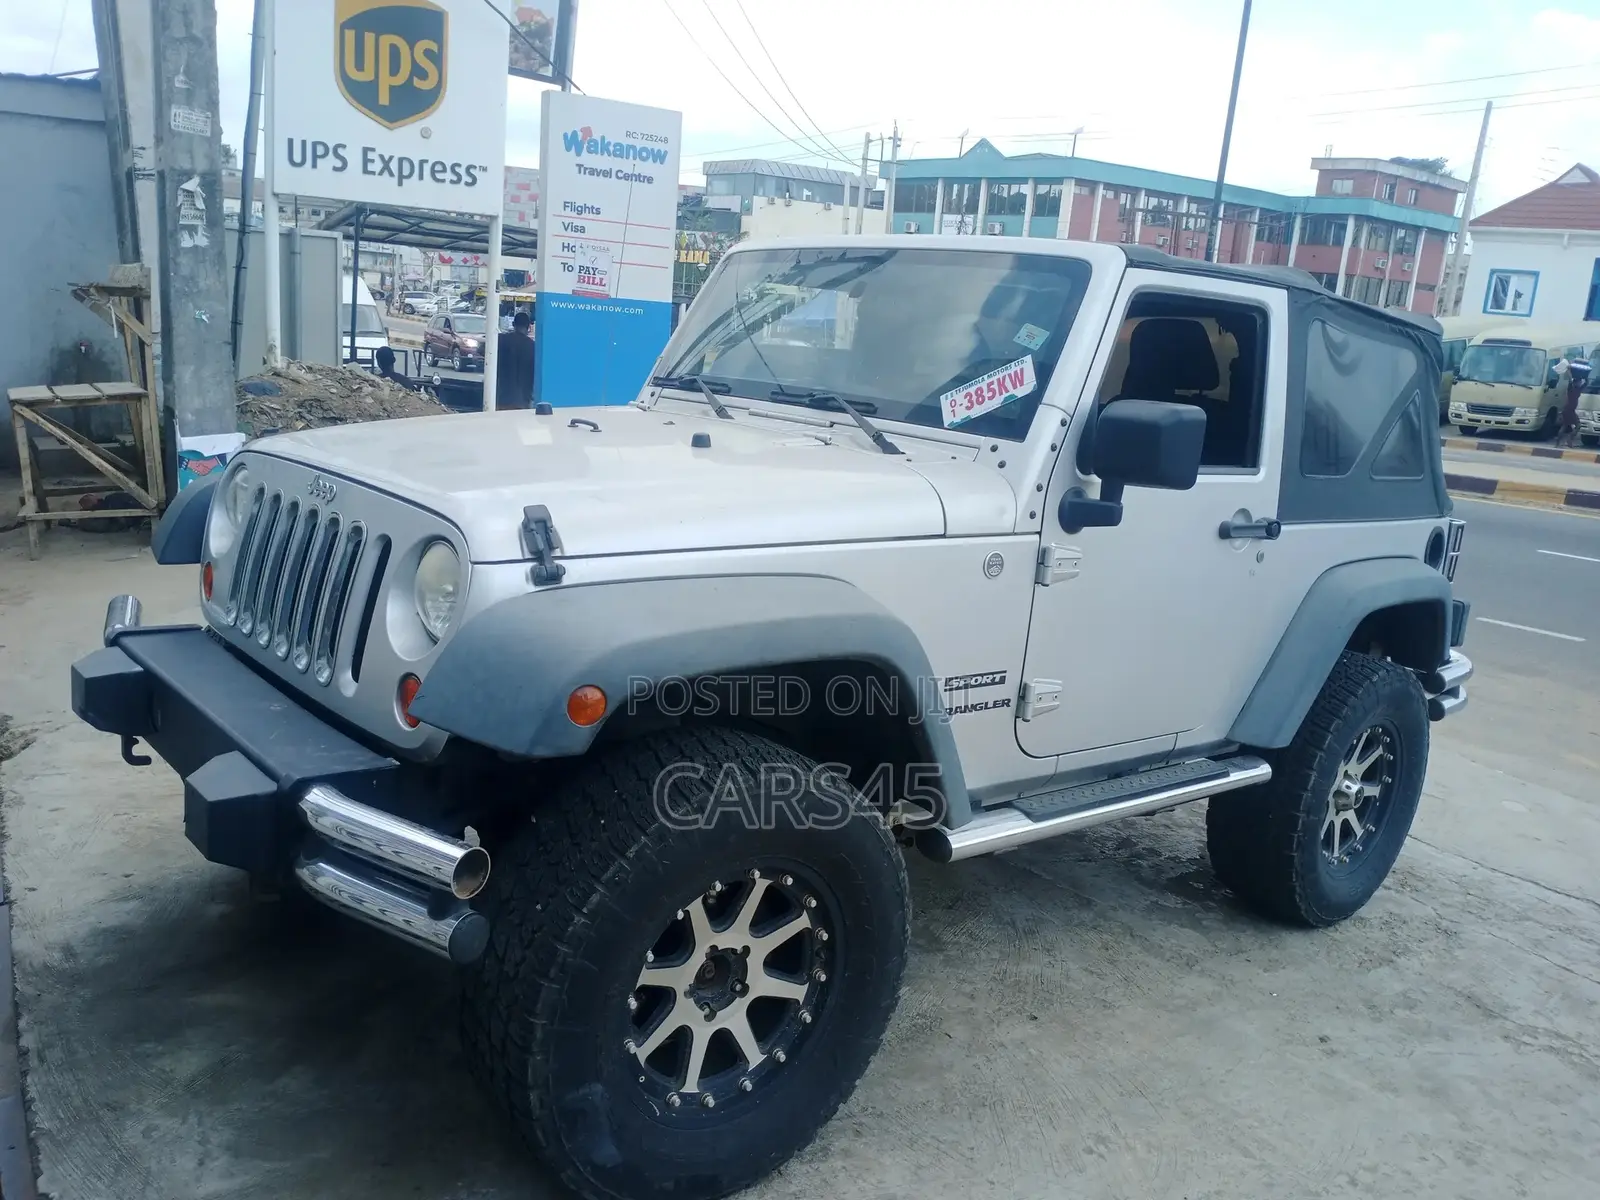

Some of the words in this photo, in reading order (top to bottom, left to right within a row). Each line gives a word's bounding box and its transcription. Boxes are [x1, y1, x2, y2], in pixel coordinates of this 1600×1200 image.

[344, 29, 439, 106] ups
[625, 130, 639, 140] RC:
[640, 133, 669, 144] 725248
[287, 137, 348, 172] UPS
[563, 129, 668, 165] Wakanow
[575, 163, 612, 179] Travel
[615, 169, 654, 184] Centre
[563, 201, 601, 216] Flights
[562, 221, 586, 234] Visa
[578, 265, 598, 276] PAY
[577, 275, 606, 288] BILL
[550, 301, 644, 315] www.wakanow.com
[986, 363, 1013, 380] MOTORS
[307, 474, 337, 505] Jeep
[948, 674, 1002, 689] SPORT
[944, 697, 1012, 716] RANGLER
